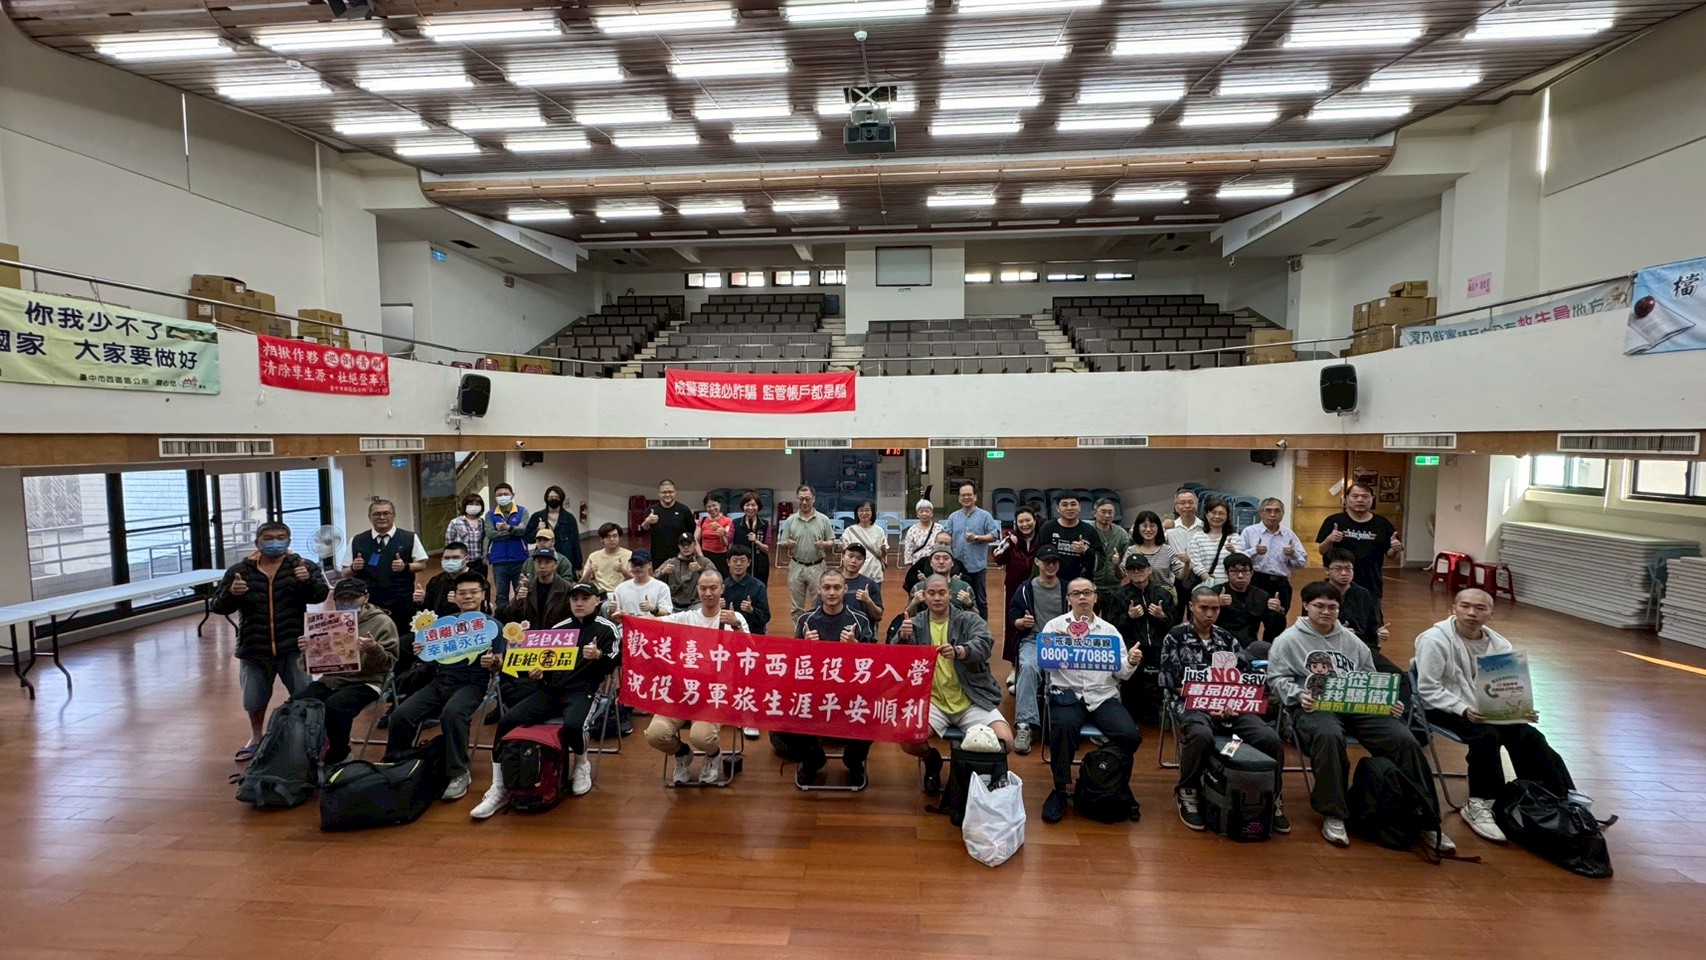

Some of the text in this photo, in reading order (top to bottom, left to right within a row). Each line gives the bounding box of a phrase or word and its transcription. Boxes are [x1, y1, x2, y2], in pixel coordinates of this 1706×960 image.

[25, 300, 163, 341] 你我少不了
[73, 339, 198, 370] 大家要做好
[674, 380, 847, 401] 檢警要錢必詐騙 監管帳戶都是騙
[426, 633, 488, 657] 幸福永在
[526, 632, 576, 647] 彩色人生
[626, 628, 930, 687] 歡送臺中市西區役男入營
[1041, 647, 1116, 663] 0800-770885
[1184, 666, 1209, 683] just
[1211, 667, 1241, 683] NO
[626, 669, 924, 730] 祝役男軍旅生涯平安順利
[1188, 684, 1258, 698] 毒品防治
